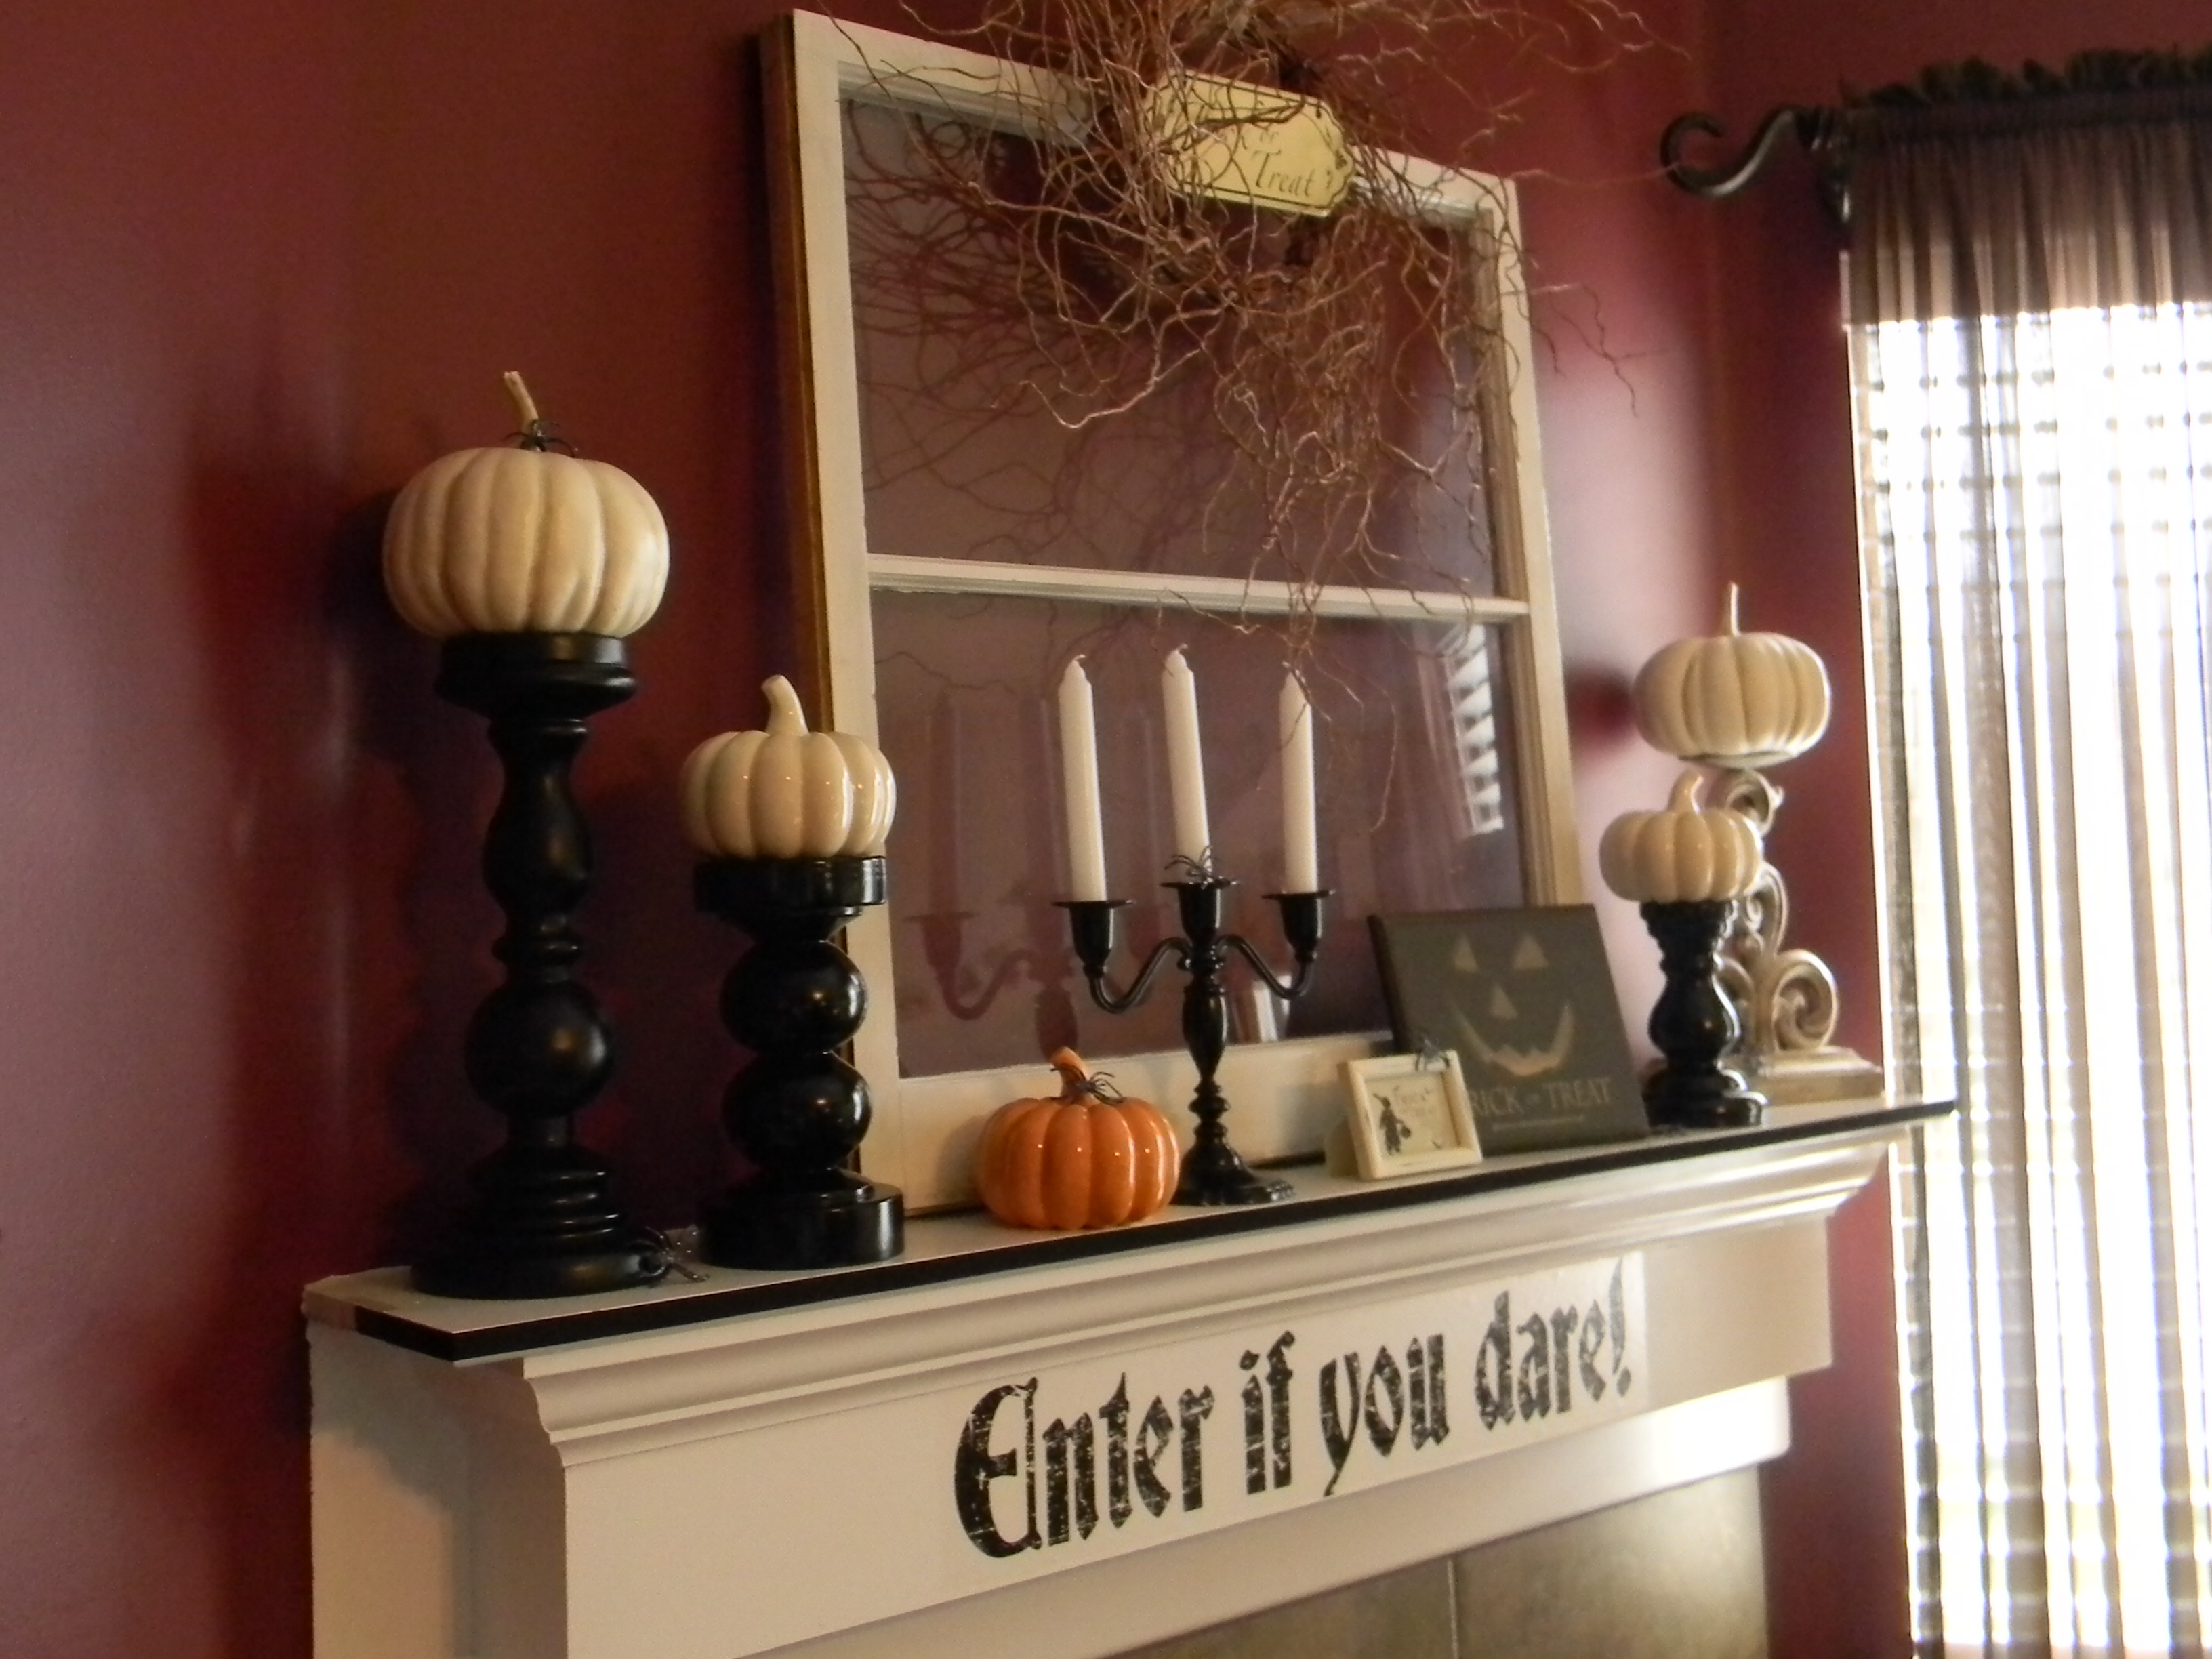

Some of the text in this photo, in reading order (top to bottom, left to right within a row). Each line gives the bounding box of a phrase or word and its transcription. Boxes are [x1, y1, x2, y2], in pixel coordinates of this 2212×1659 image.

[1251, 149, 1316, 197] Treat
[1468, 1086, 1525, 1116] RICK
[1541, 1076, 1611, 1109] TREAT
[954, 1256, 1632, 1559] Enter if you dare!
